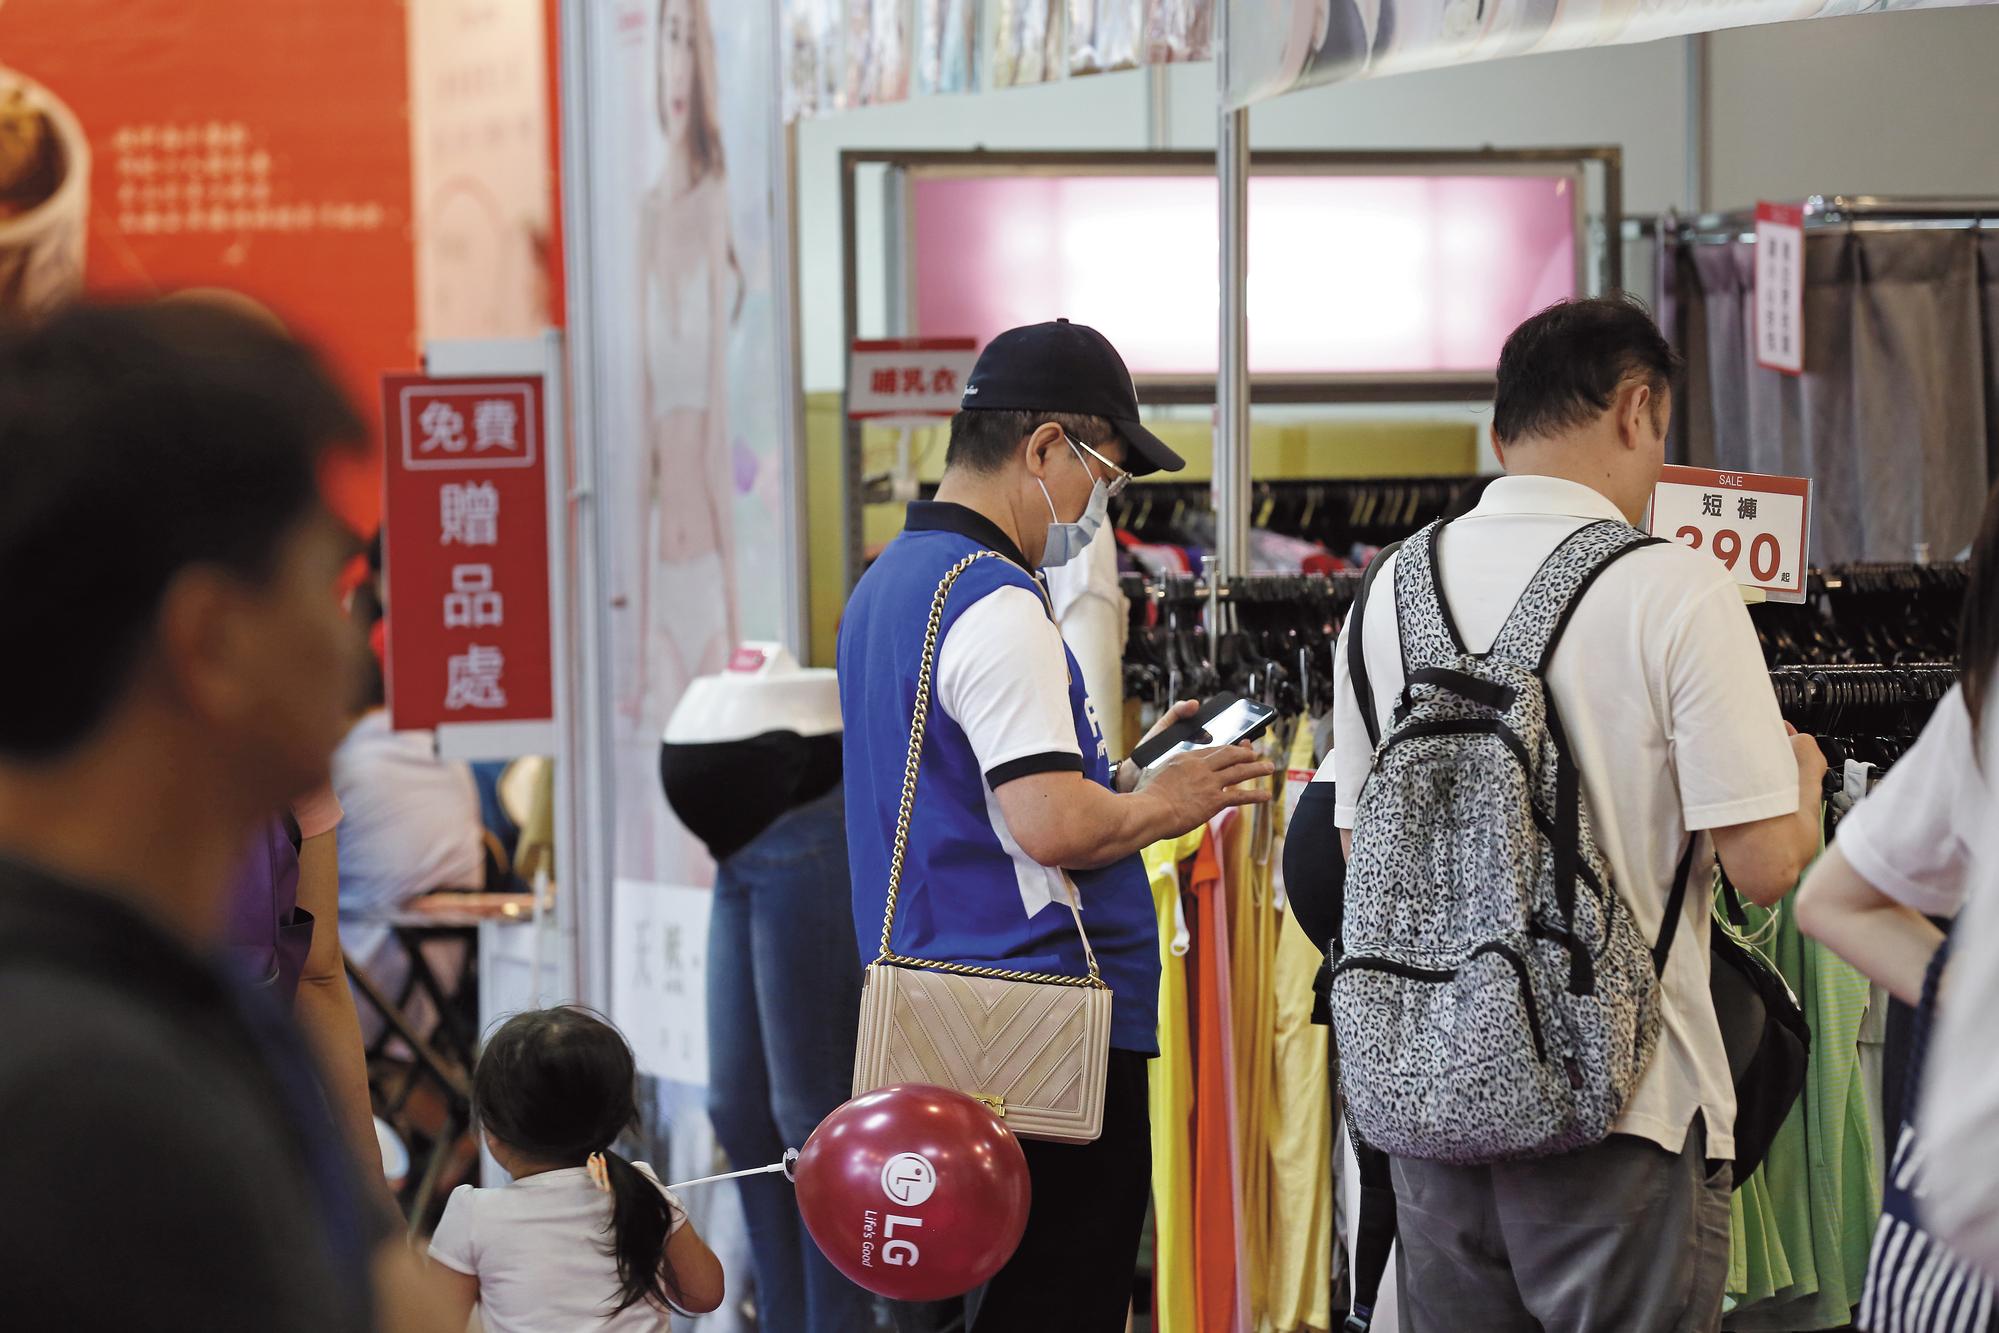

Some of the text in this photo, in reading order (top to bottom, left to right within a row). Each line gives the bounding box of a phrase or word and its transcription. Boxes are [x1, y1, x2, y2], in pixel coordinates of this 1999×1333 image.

[870, 367, 958, 395] 哺乳衣
[418, 401, 518, 452] 免費
[1719, 474, 1743, 487] SALE
[1702, 493, 1758, 520] 短褲
[439, 480, 507, 710] 贈品處
[861, 1210, 878, 1268] Life's Good
[882, 1214, 923, 1267] LG
